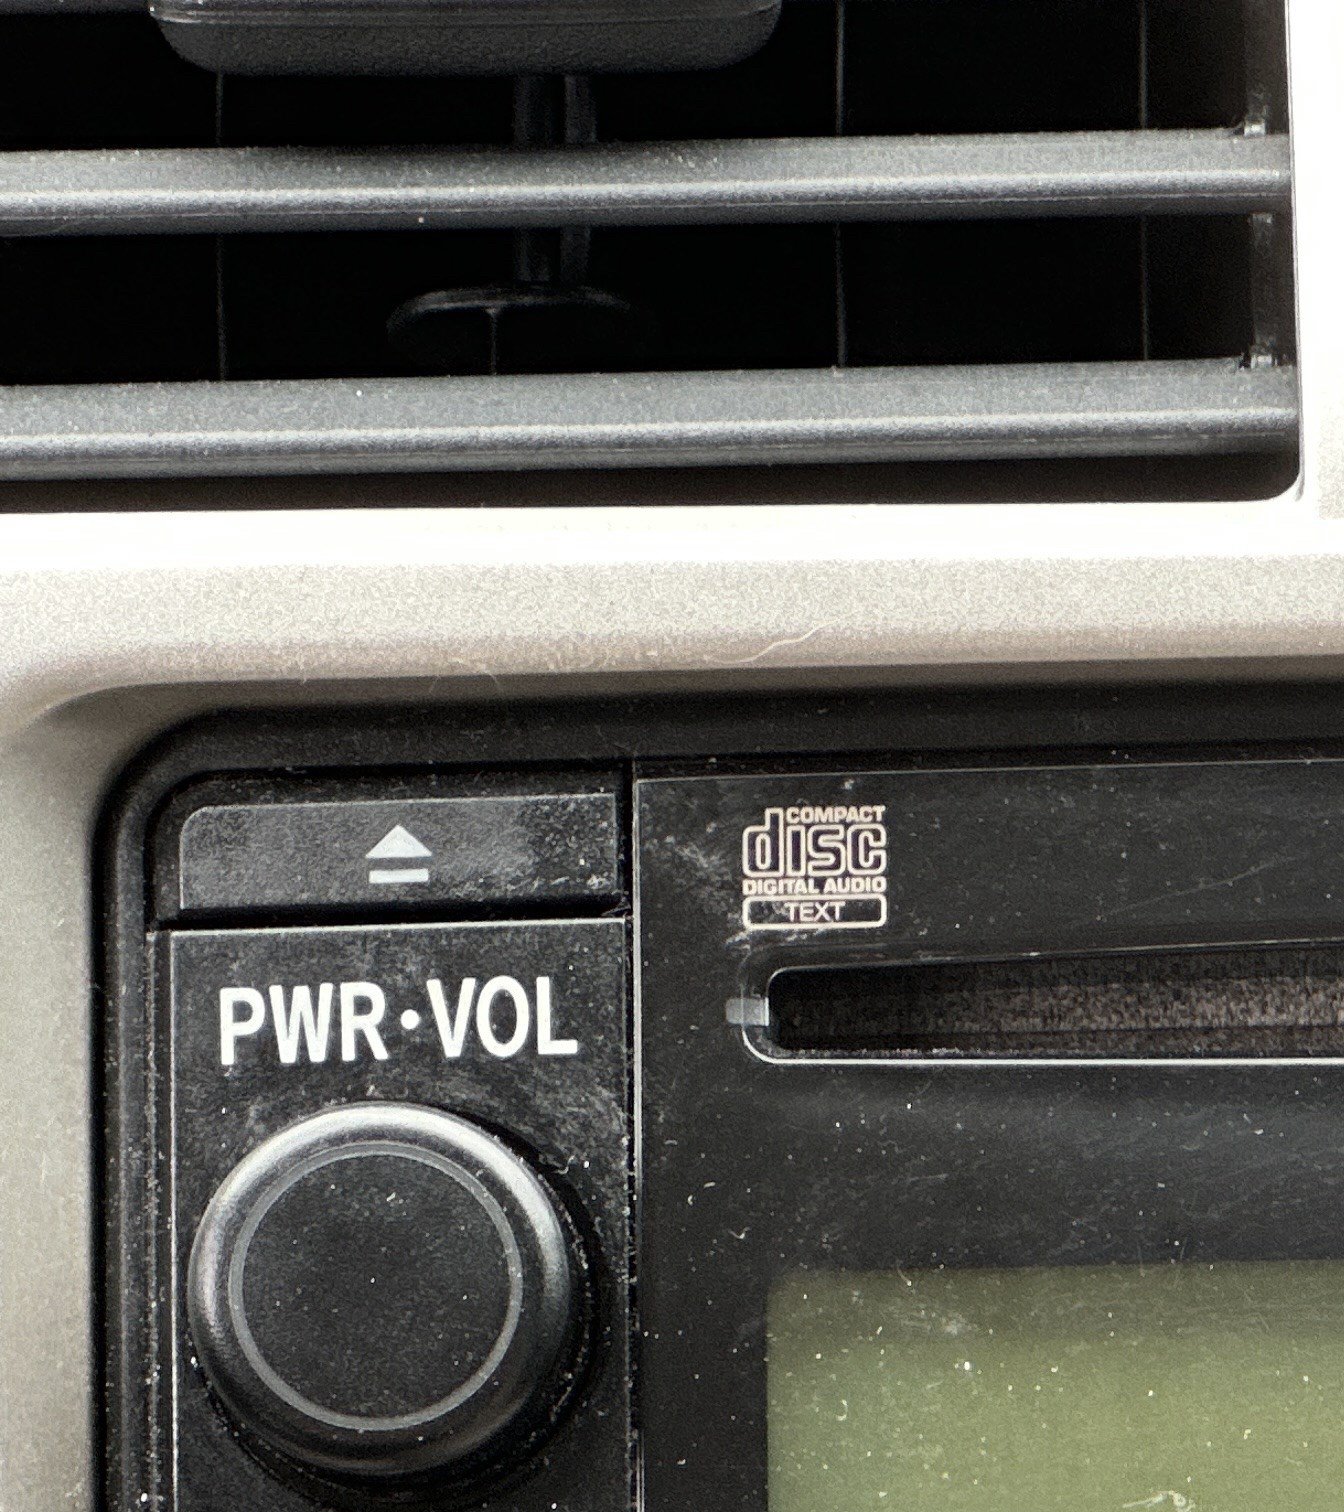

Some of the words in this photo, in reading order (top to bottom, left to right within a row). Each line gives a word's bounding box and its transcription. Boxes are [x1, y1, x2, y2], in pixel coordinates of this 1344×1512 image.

[786, 805, 886, 823] COMPACT
[742, 807, 886, 877] disc
[742, 878, 820, 895] DIGITAL
[823, 876, 886, 894] AUDIO
[785, 902, 846, 921] TEXT
